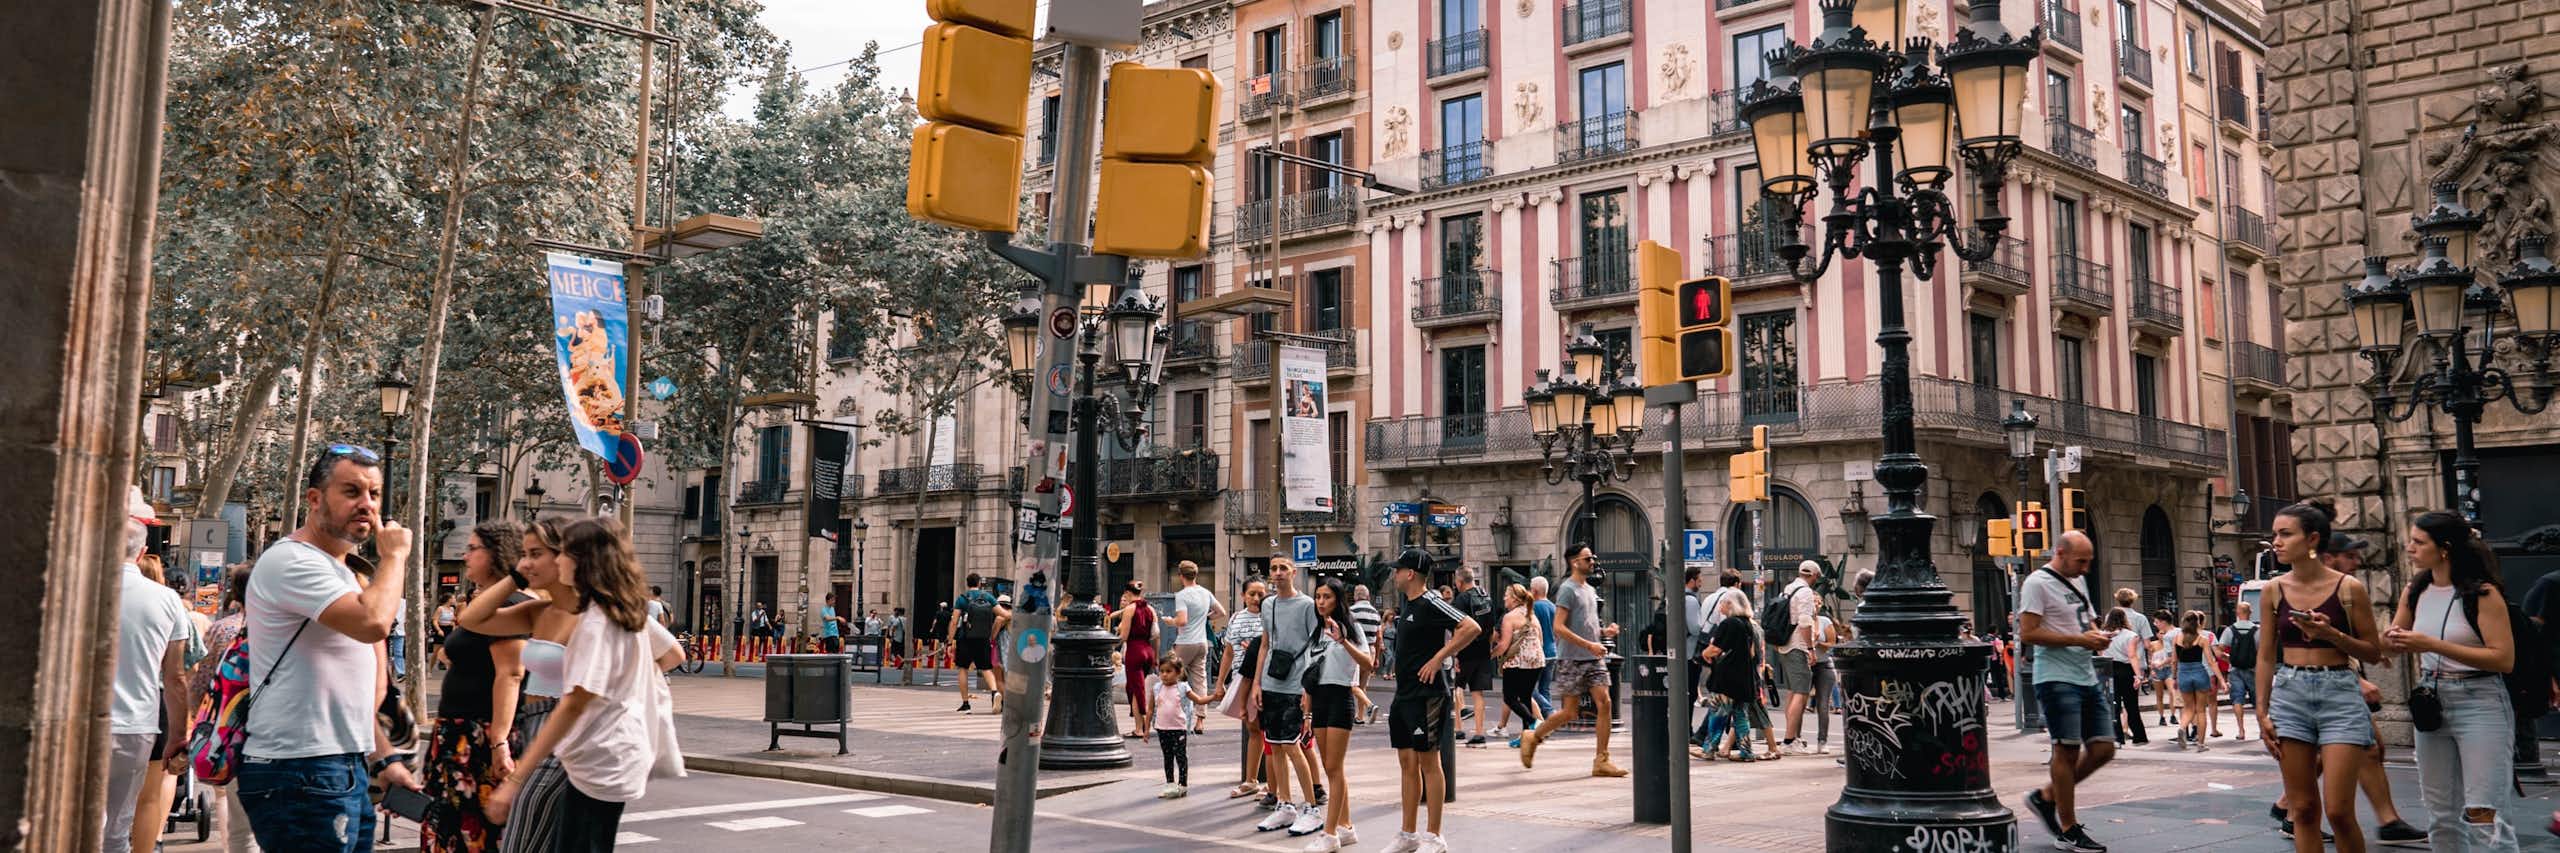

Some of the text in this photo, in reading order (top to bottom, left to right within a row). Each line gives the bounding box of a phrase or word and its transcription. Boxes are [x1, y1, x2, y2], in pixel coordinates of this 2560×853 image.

[655, 383, 671, 395] W
[1298, 539, 1312, 559] P
[1690, 533, 1709, 557] P
[1764, 553, 1804, 561] EGULADOR
